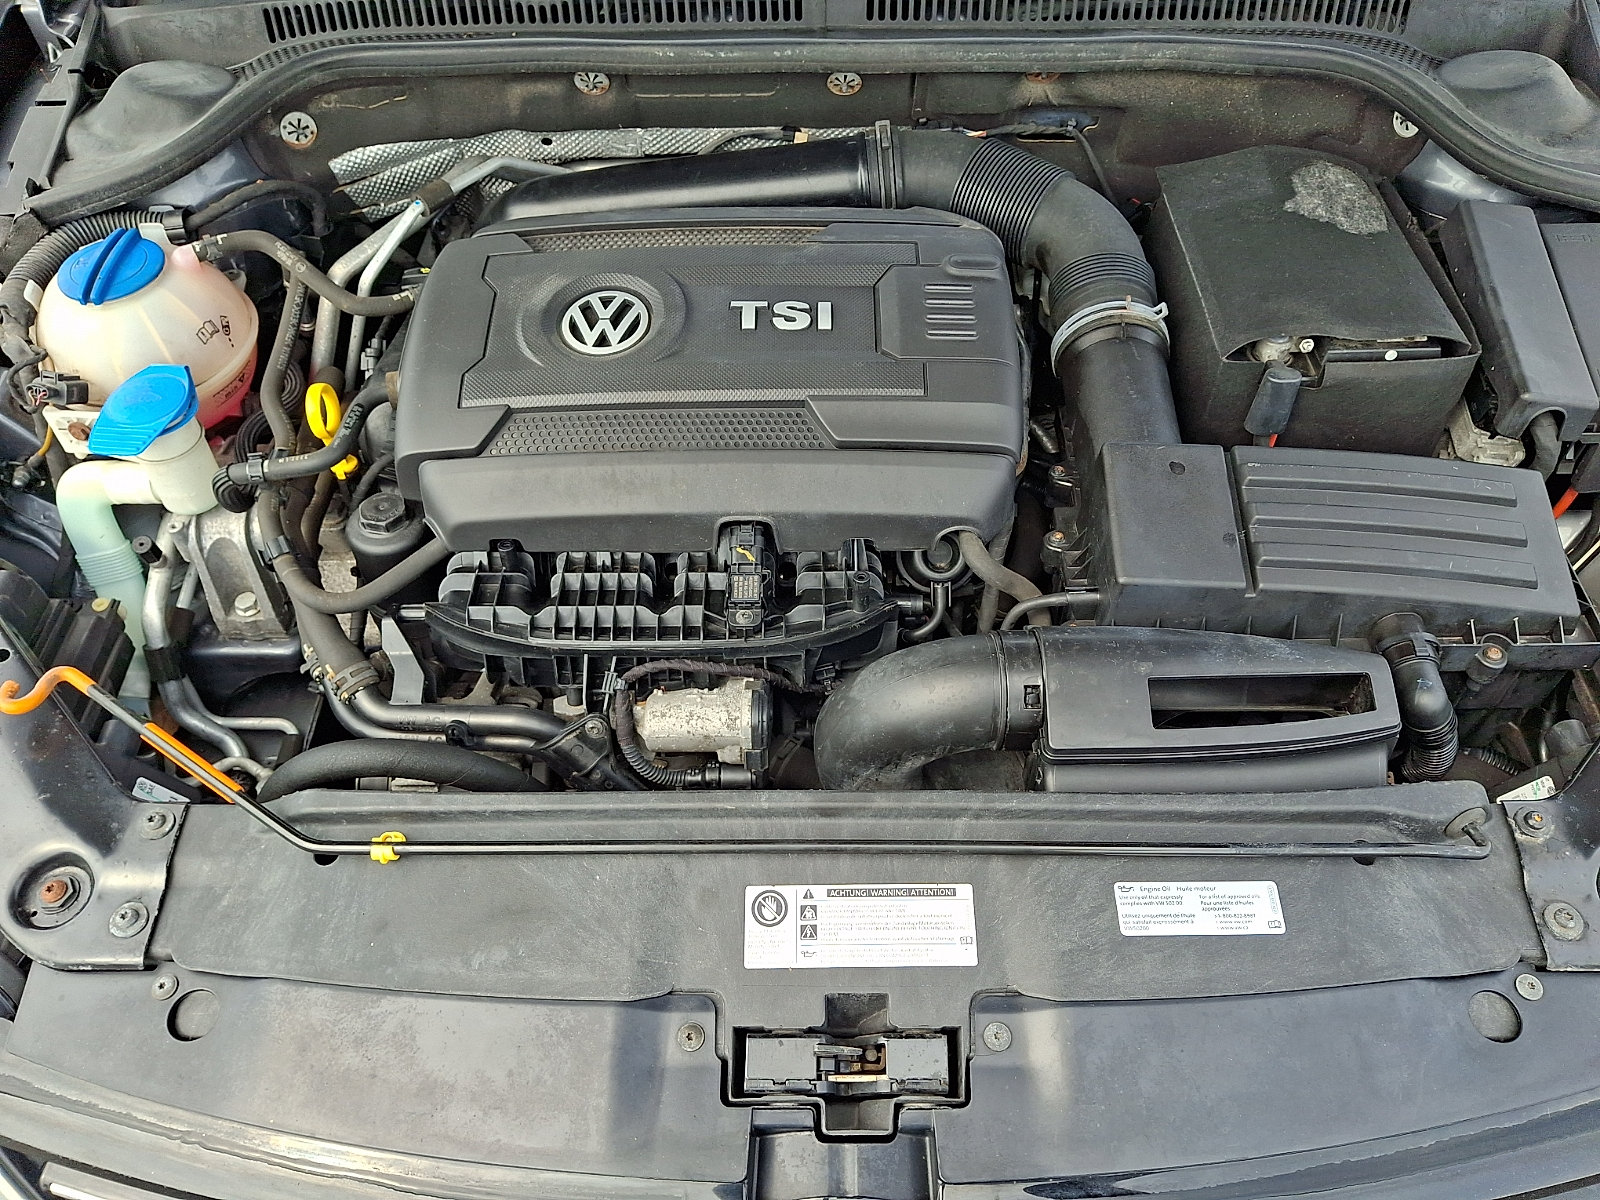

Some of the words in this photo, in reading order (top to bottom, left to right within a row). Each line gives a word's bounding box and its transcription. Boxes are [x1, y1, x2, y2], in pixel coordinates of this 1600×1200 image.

[561, 290, 649, 355] VW
[730, 301, 832, 331] TSI
[830, 889, 869, 897] ACHTUNG!
[870, 889, 910, 897] WARNING!
[911, 888, 955, 896] ATTENTION!
[1139, 885, 1161, 893] Engine
